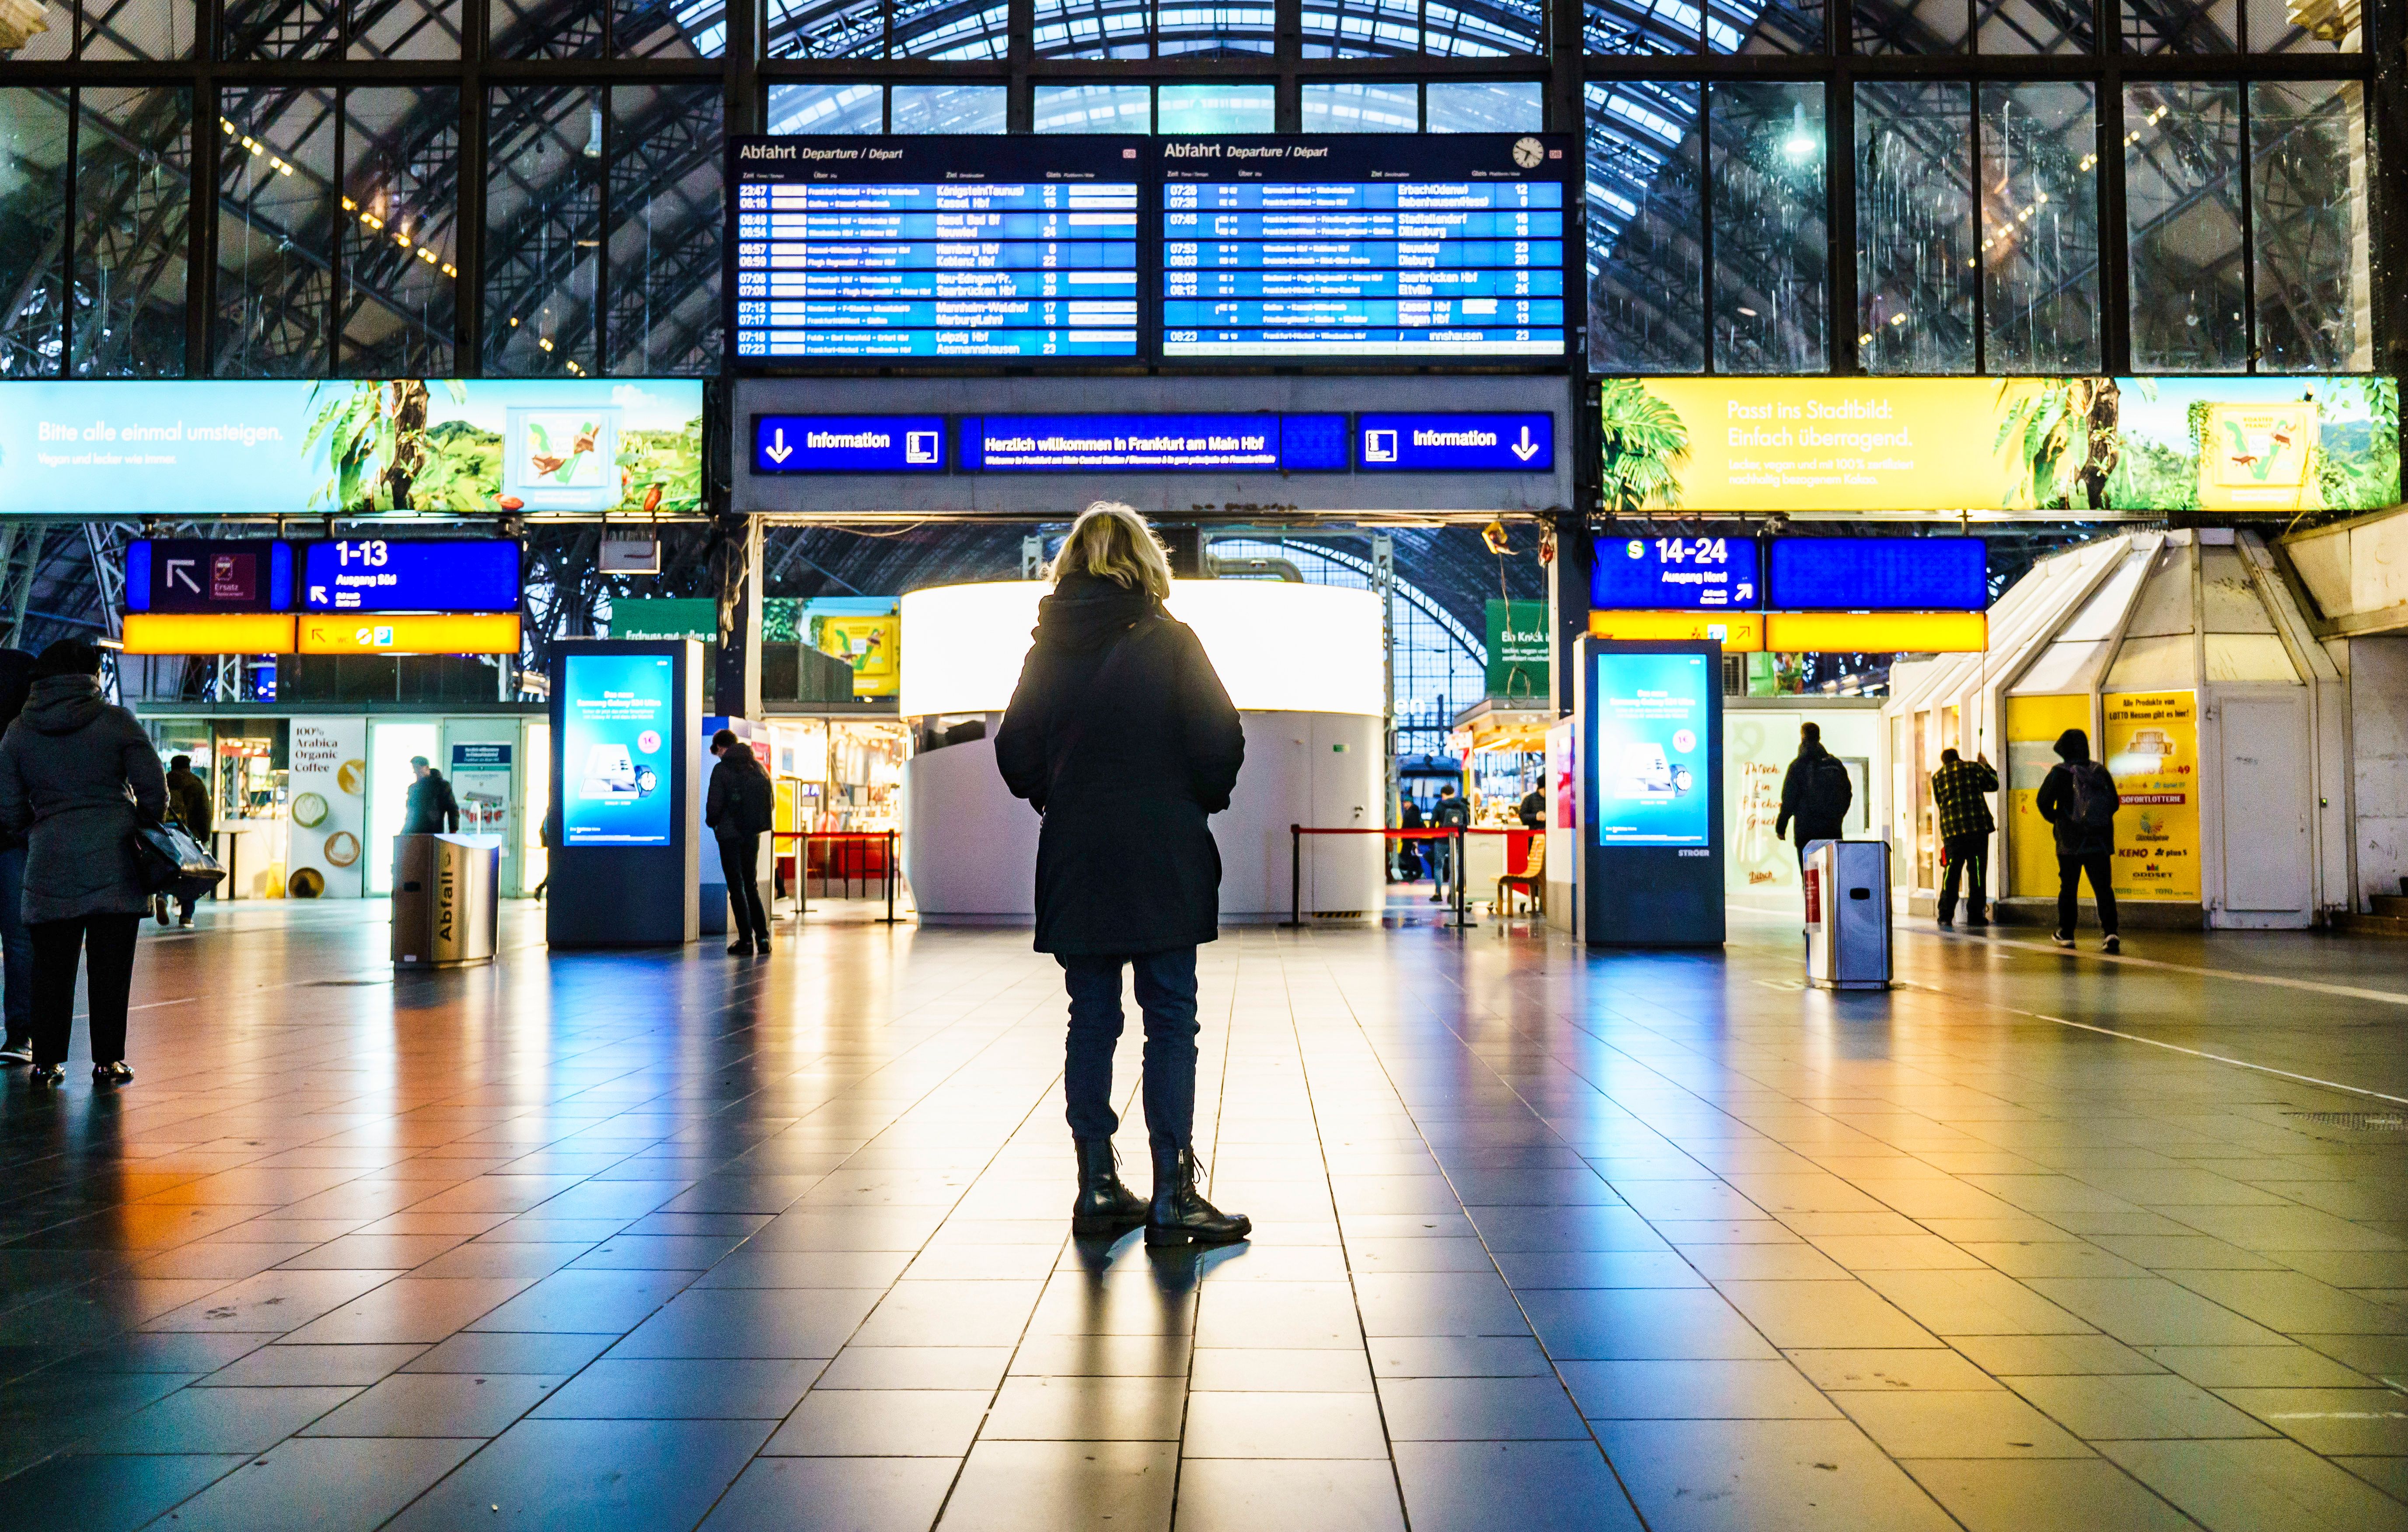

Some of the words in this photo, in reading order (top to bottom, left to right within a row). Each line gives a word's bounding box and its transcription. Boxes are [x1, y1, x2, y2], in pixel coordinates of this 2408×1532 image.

[740, 145, 796, 159] Abfahrt
[803, 148, 858, 160] Departure
[869, 149, 902, 160] Départ
[1164, 143, 1221, 157] Abfahrt
[1227, 146, 1282, 159] Departure
[1293, 147, 1328, 158] Départ
[1043, 186, 1056, 195] 22
[1515, 185, 1527, 194] 12
[973, 198, 989, 208] Hbf
[1044, 198, 1056, 207] 15
[1516, 213, 1528, 223] 16
[1043, 226, 1056, 237] 24
[1516, 226, 1528, 235] 16
[936, 244, 979, 256] Hamburg
[982, 244, 999, 254] Hbf
[1515, 243, 1528, 253] 23
[937, 256, 974, 266] Koblenz
[978, 256, 995, 266] Hbf
[1043, 255, 1056, 266] 22
[1515, 254, 1528, 265] 20
[1044, 273, 1056, 283] 10
[1461, 272, 1477, 282] Hbf
[1516, 272, 1528, 282] 18
[1000, 286, 1016, 296] Hbf
[1043, 286, 1056, 296] 20
[1515, 284, 1528, 294] 24
[1044, 303, 1055, 312] 17
[1434, 302, 1450, 311] Hbf
[1517, 301, 1529, 311] 13
[1044, 314, 1055, 324] 15
[1433, 314, 1449, 324] Hbf
[1517, 313, 1528, 323] 13
[973, 332, 988, 341] Hbf
[1516, 331, 1529, 340] 23
[937, 345, 1019, 354] Assmannshausen
[1043, 344, 1056, 354] 23
[1727, 400, 1773, 419] Passt
[1777, 401, 1801, 419] ins
[1806, 399, 1893, 419] Stadtbild:
[38, 421, 78, 442] Bitte
[83, 421, 117, 441] alle
[121, 420, 182, 442] einmal
[186, 423, 283, 447] umsteigen.
[1413, 430, 1497, 446] Information
[807, 432, 890, 448] Information
[985, 438, 1035, 451] Herzlich
[1037, 438, 1112, 451] willkommen
[1114, 438, 1126, 451] in
[1128, 437, 1185, 451] Frankfurt
[1186, 439, 1206, 450] am
[1208, 437, 1239, 451] Main
[1241, 436, 1264, 450] Hbf
[1728, 426, 1793, 447] Einfach
[1799, 426, 1913, 453] überragend.
[37, 453, 70, 468] Vegan
[72, 452, 92, 464] und
[93, 452, 123, 464] lecker
[125, 453, 143, 464] wie
[145, 453, 177, 464] immer.
[1728, 459, 1762, 472] Lecker,
[1763, 461, 1795, 473] vegan
[1797, 458, 1817, 470] und
[1819, 459, 1833, 470] mit
[1728, 473, 1780, 488] nachhaltig
[1782, 474, 1842, 488] bezogenem
[1843, 474, 1878, 485] Kakao.
[335, 540, 388, 567] 1-13
[1628, 540, 1644, 559] S
[1655, 538, 1727, 564] 14-24
[335, 574, 377, 588] Ausgang
[377, 573, 397, 585] Süd
[1662, 571, 1703, 585] Ausgang
[1703, 571, 1727, 583] Nord
[214, 583, 238, 591] Ersatz
[2109, 711, 2129, 721] LOTTO
[2153, 710, 2164, 720] gibt
[296, 727, 325, 736] 100%
[295, 737, 338, 749] Arabica
[295, 749, 338, 760] Organic
[295, 762, 330, 773] Coffee
[2178, 765, 2190, 774] 49
[2121, 795, 2181, 804] SOFORTLOTTERIE
[2118, 848, 2148, 858] KENO
[440, 871, 453, 942] Abfall
